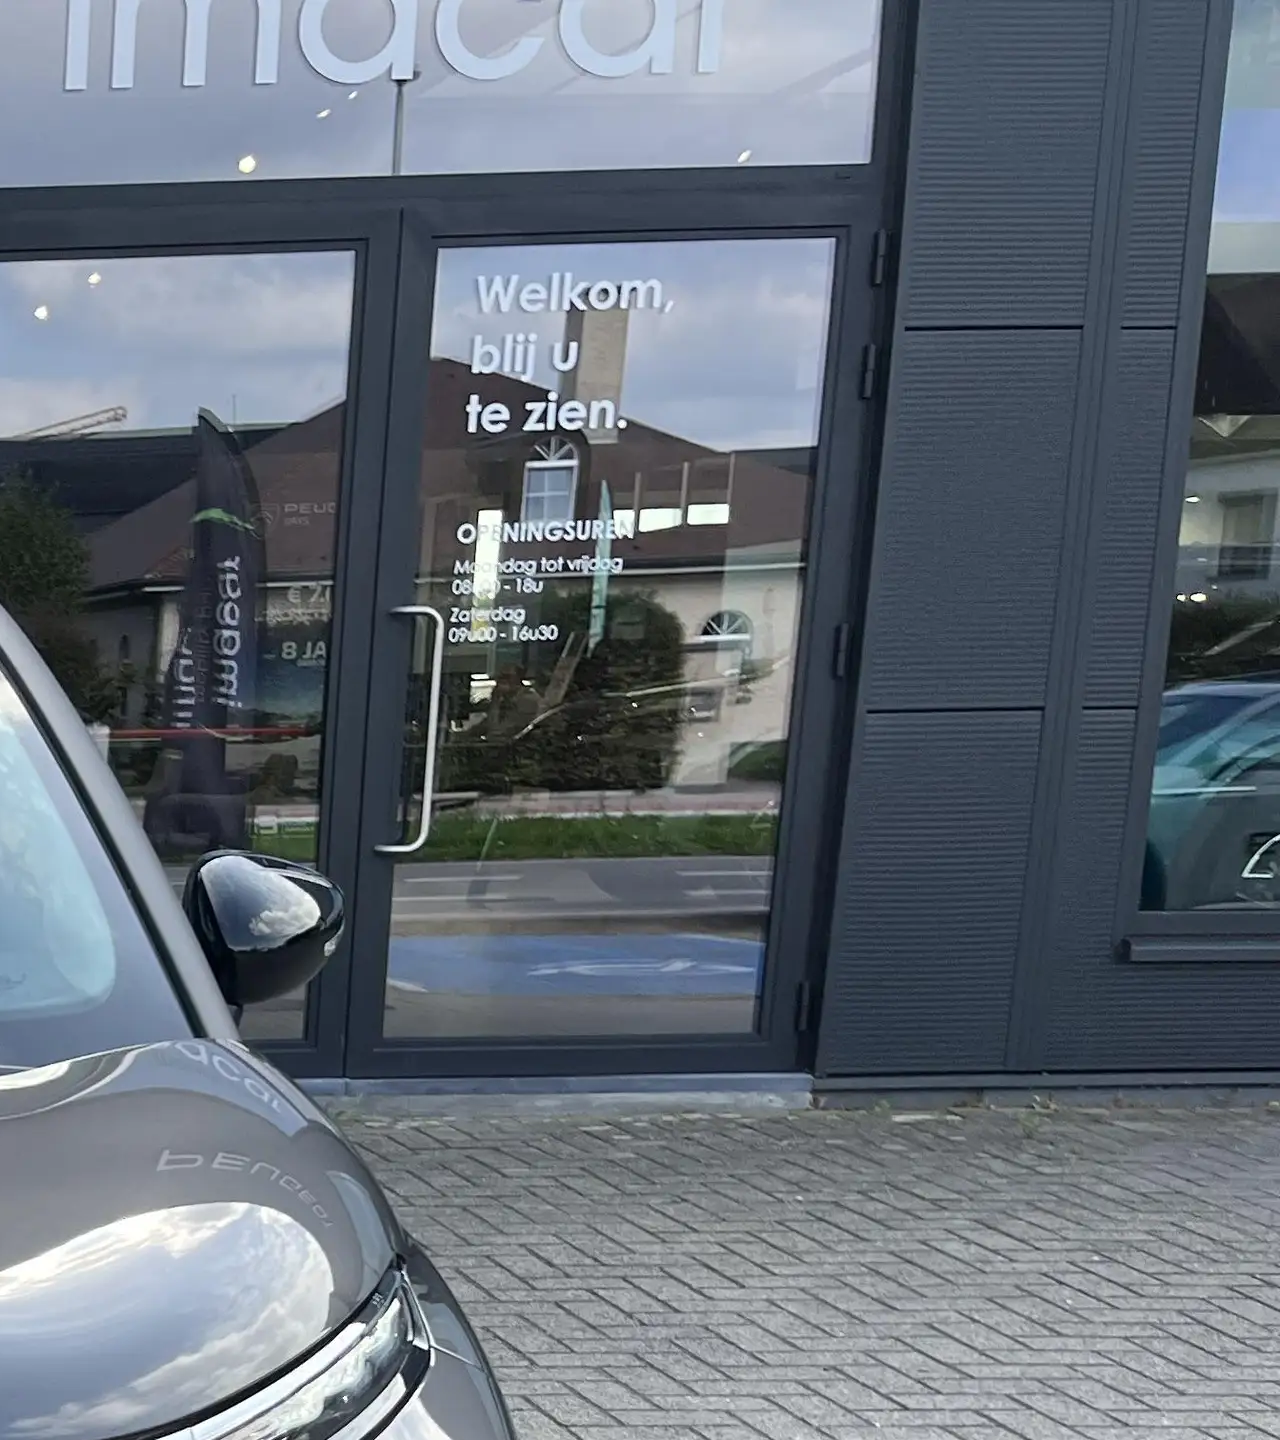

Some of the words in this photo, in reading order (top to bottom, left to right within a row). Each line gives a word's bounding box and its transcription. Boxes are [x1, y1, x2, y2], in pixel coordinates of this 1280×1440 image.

[477, 272, 675, 314] Welkom,
[470, 333, 538, 382] blij
[551, 341, 579, 373] u
[465, 394, 511, 434] te
[522, 391, 629, 432] zien.
[456, 518, 635, 545] OPENINGSUREN
[453, 558, 537, 576] Maandag
[540, 556, 565, 573] tot
[567, 555, 624, 575] vrijdag
[451, 578, 501, 595] 0800
[515, 579, 544, 595] 18u
[449, 606, 527, 625] Zaterdag
[448, 626, 497, 643] 09u00
[512, 625, 559, 641] 16u30
